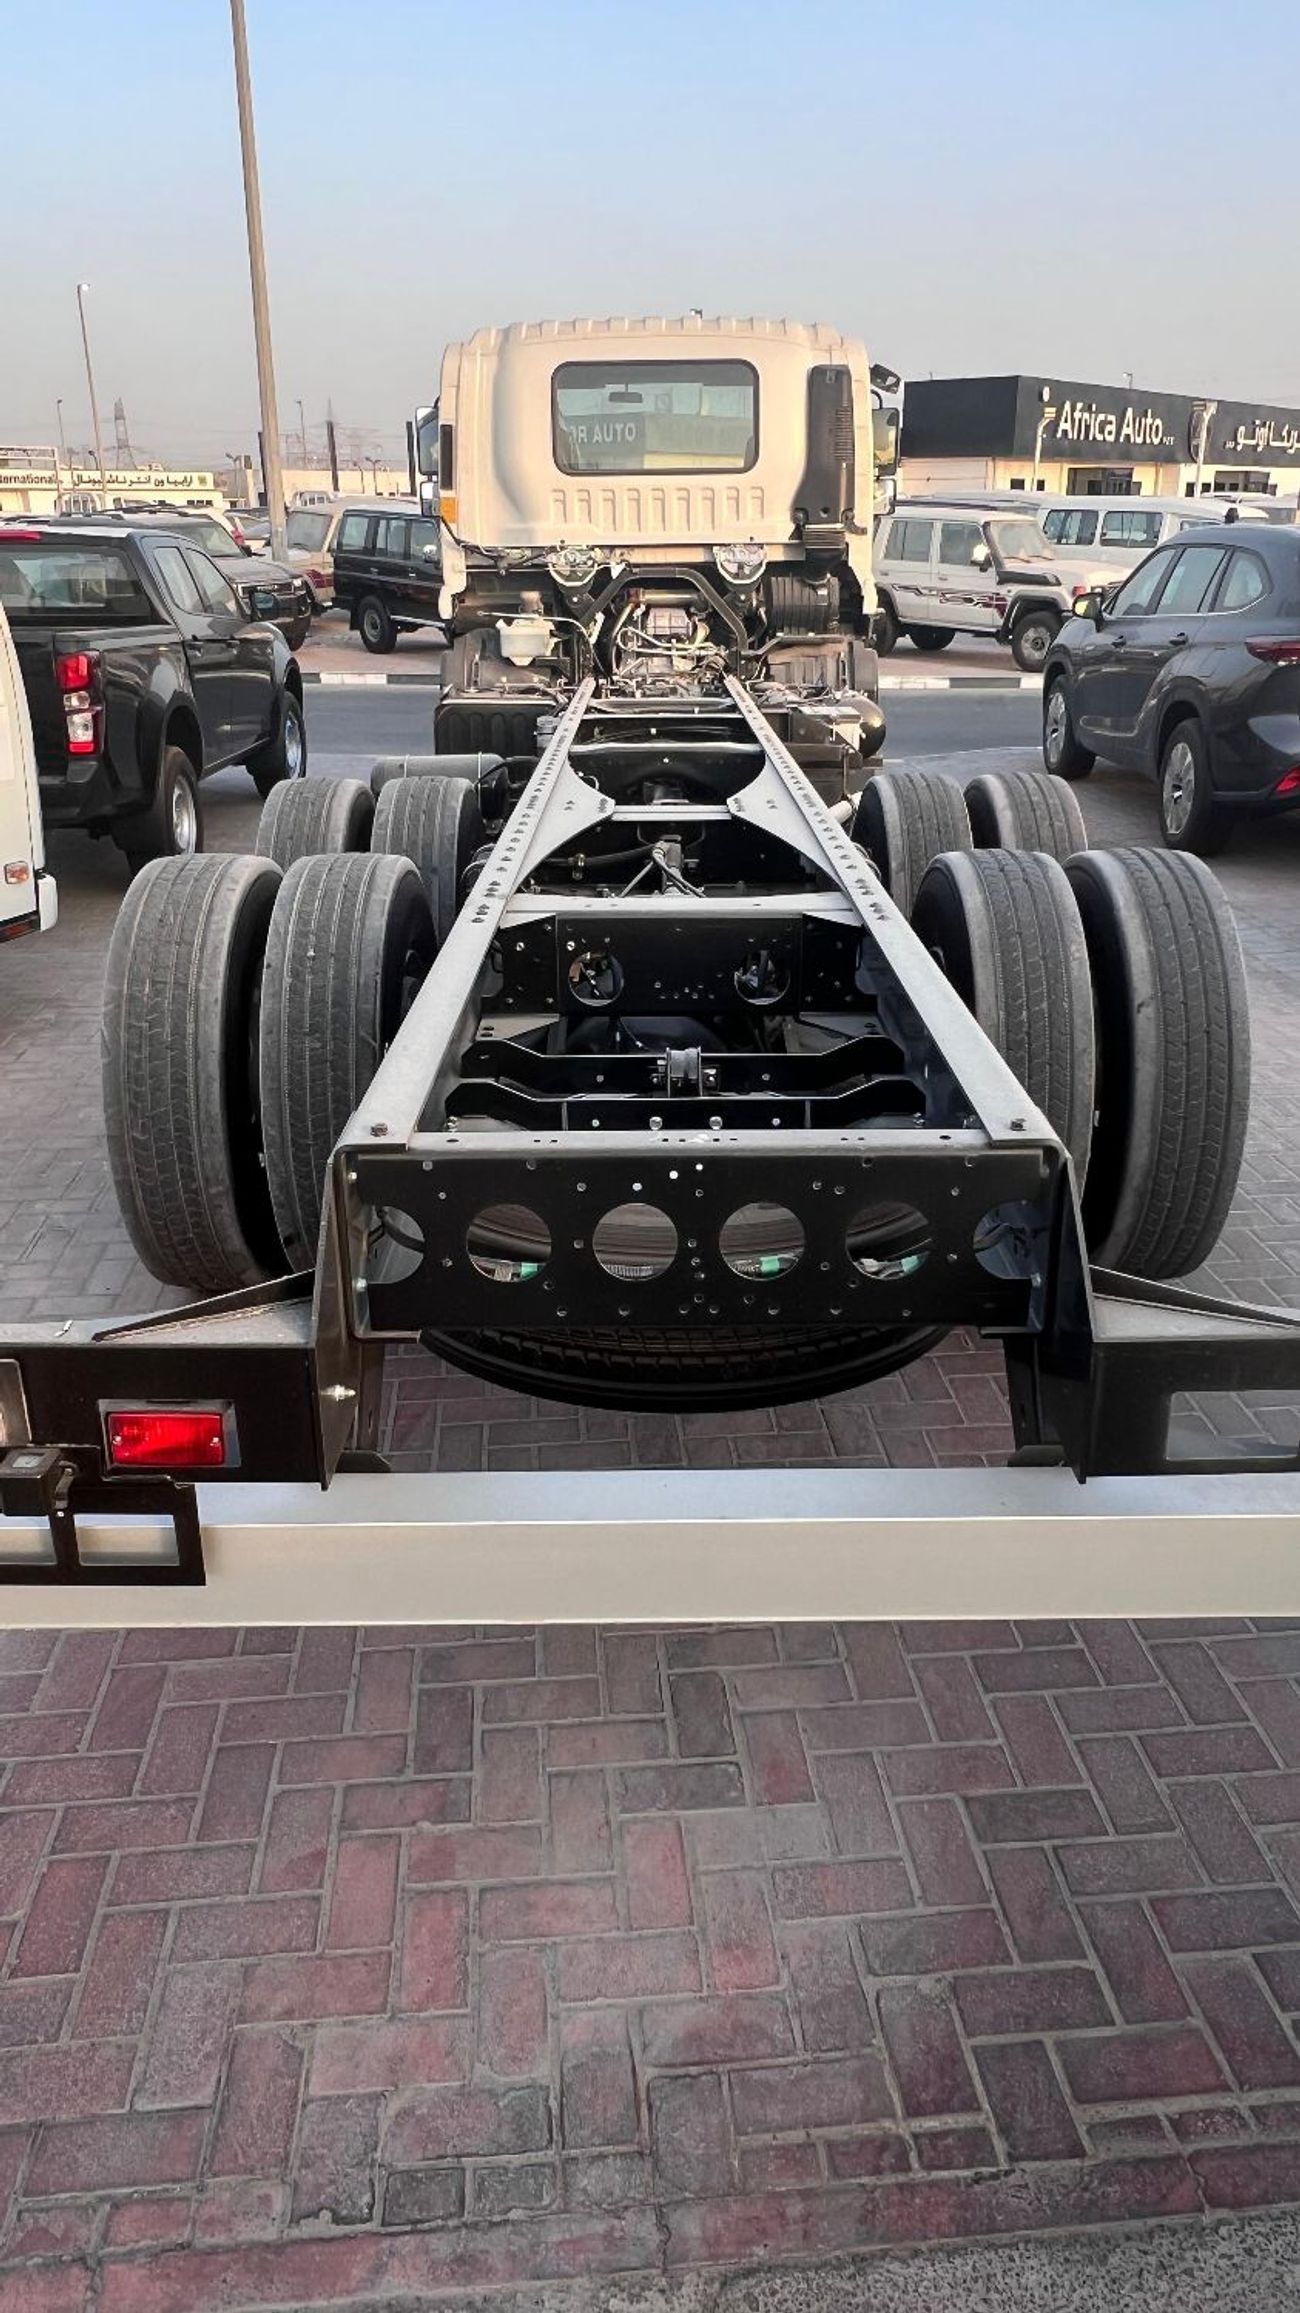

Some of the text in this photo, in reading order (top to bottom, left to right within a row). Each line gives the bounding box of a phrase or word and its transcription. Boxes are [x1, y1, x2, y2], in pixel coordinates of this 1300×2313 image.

[593, 422, 637, 443] AUTO
[1056, 400, 1163, 445] Africa Auto
